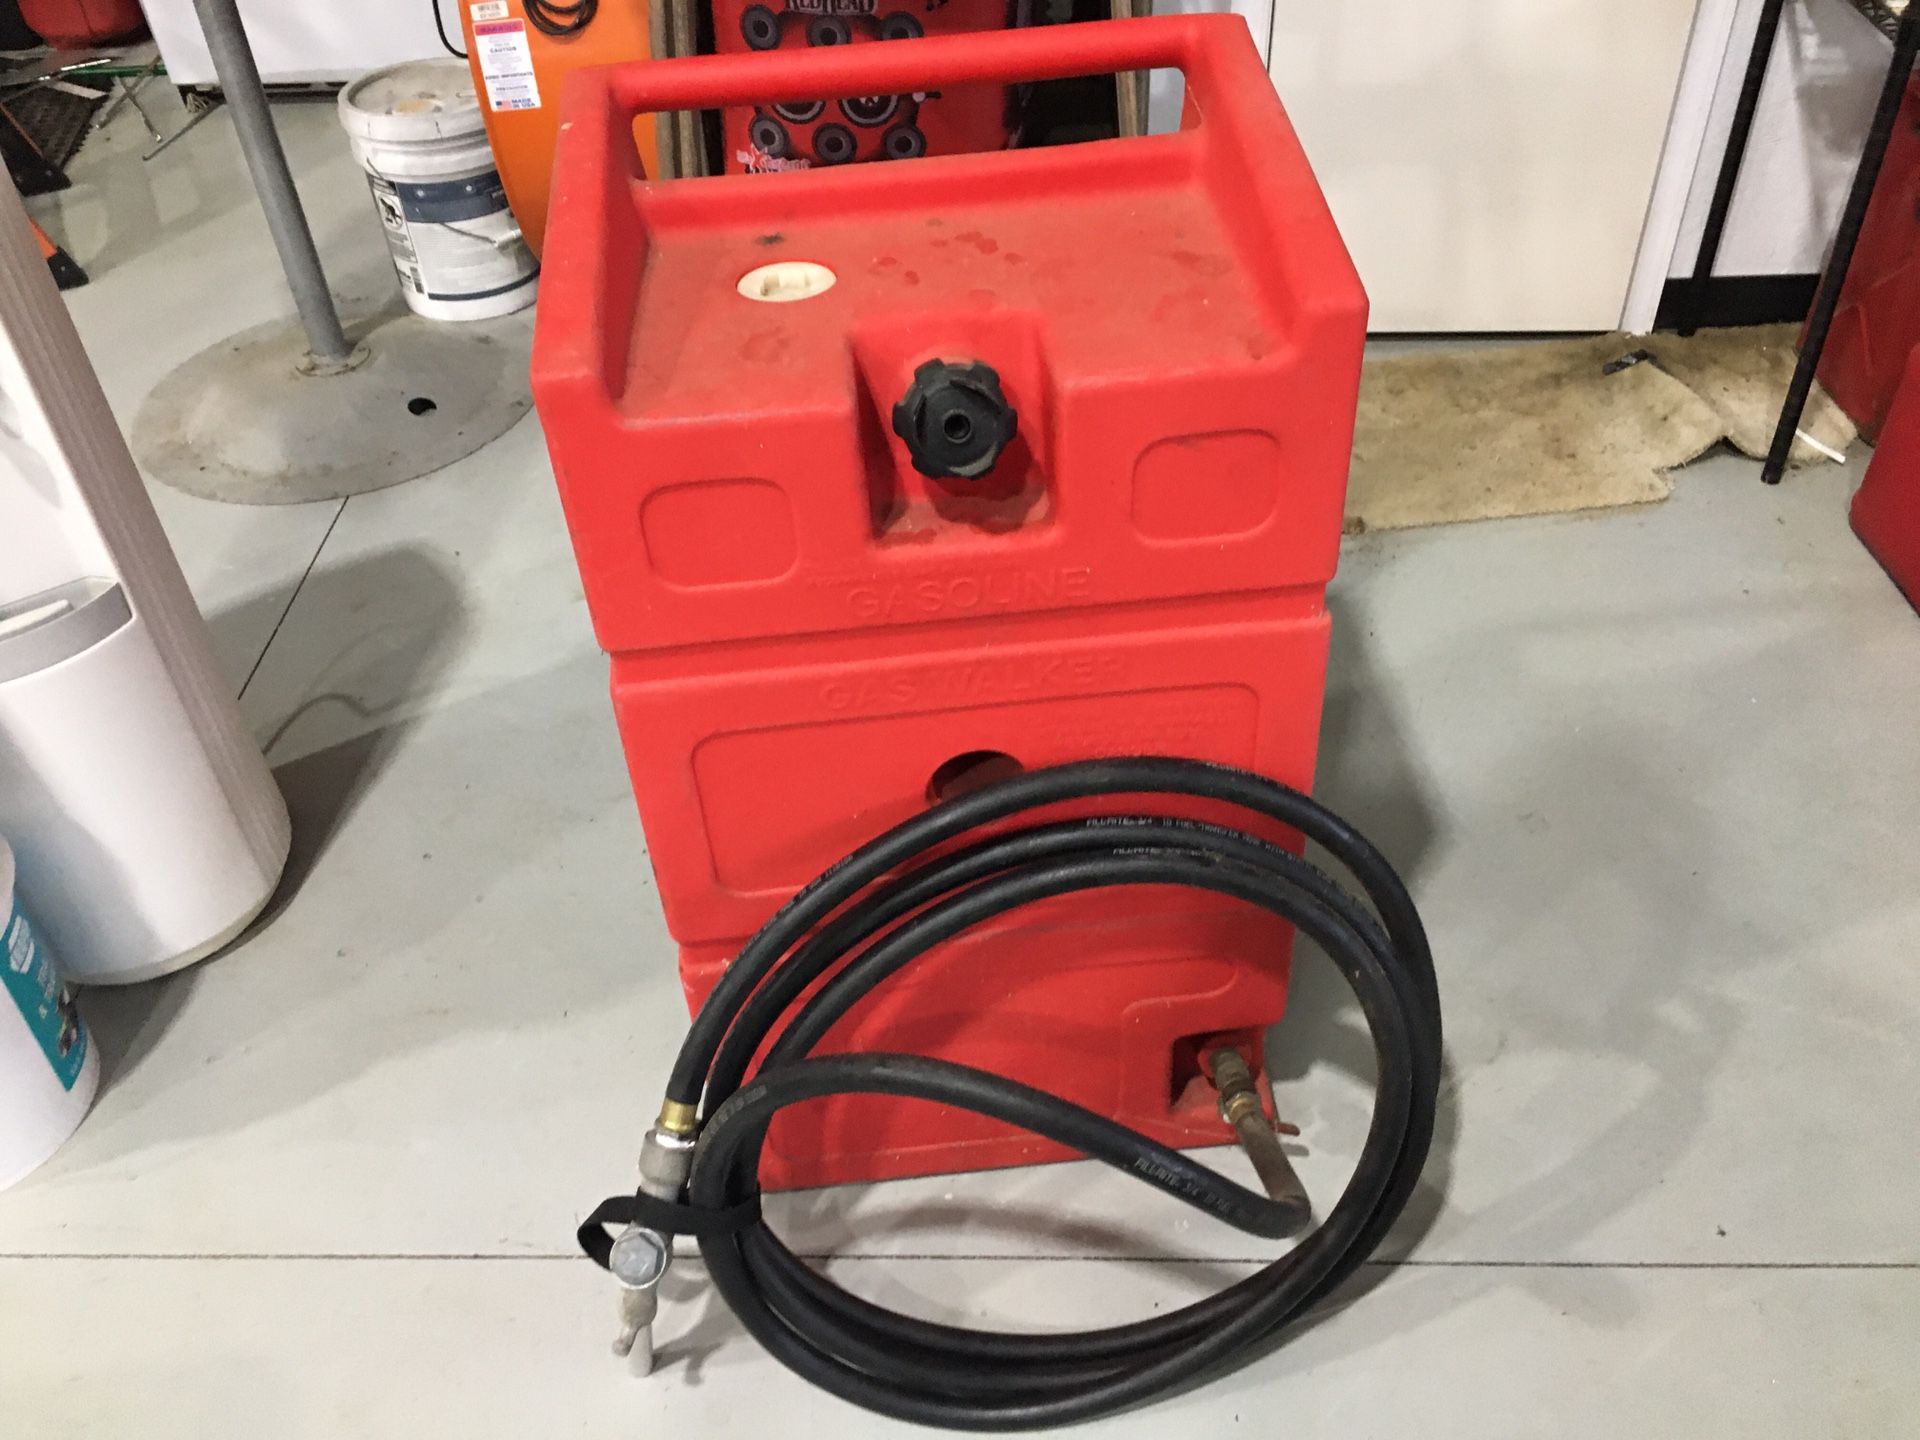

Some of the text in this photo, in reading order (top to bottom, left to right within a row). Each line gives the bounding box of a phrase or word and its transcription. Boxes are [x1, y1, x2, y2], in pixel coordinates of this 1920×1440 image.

[846, 566, 1091, 618] GASOLINE
[818, 654, 1125, 711] GAS WALKER
